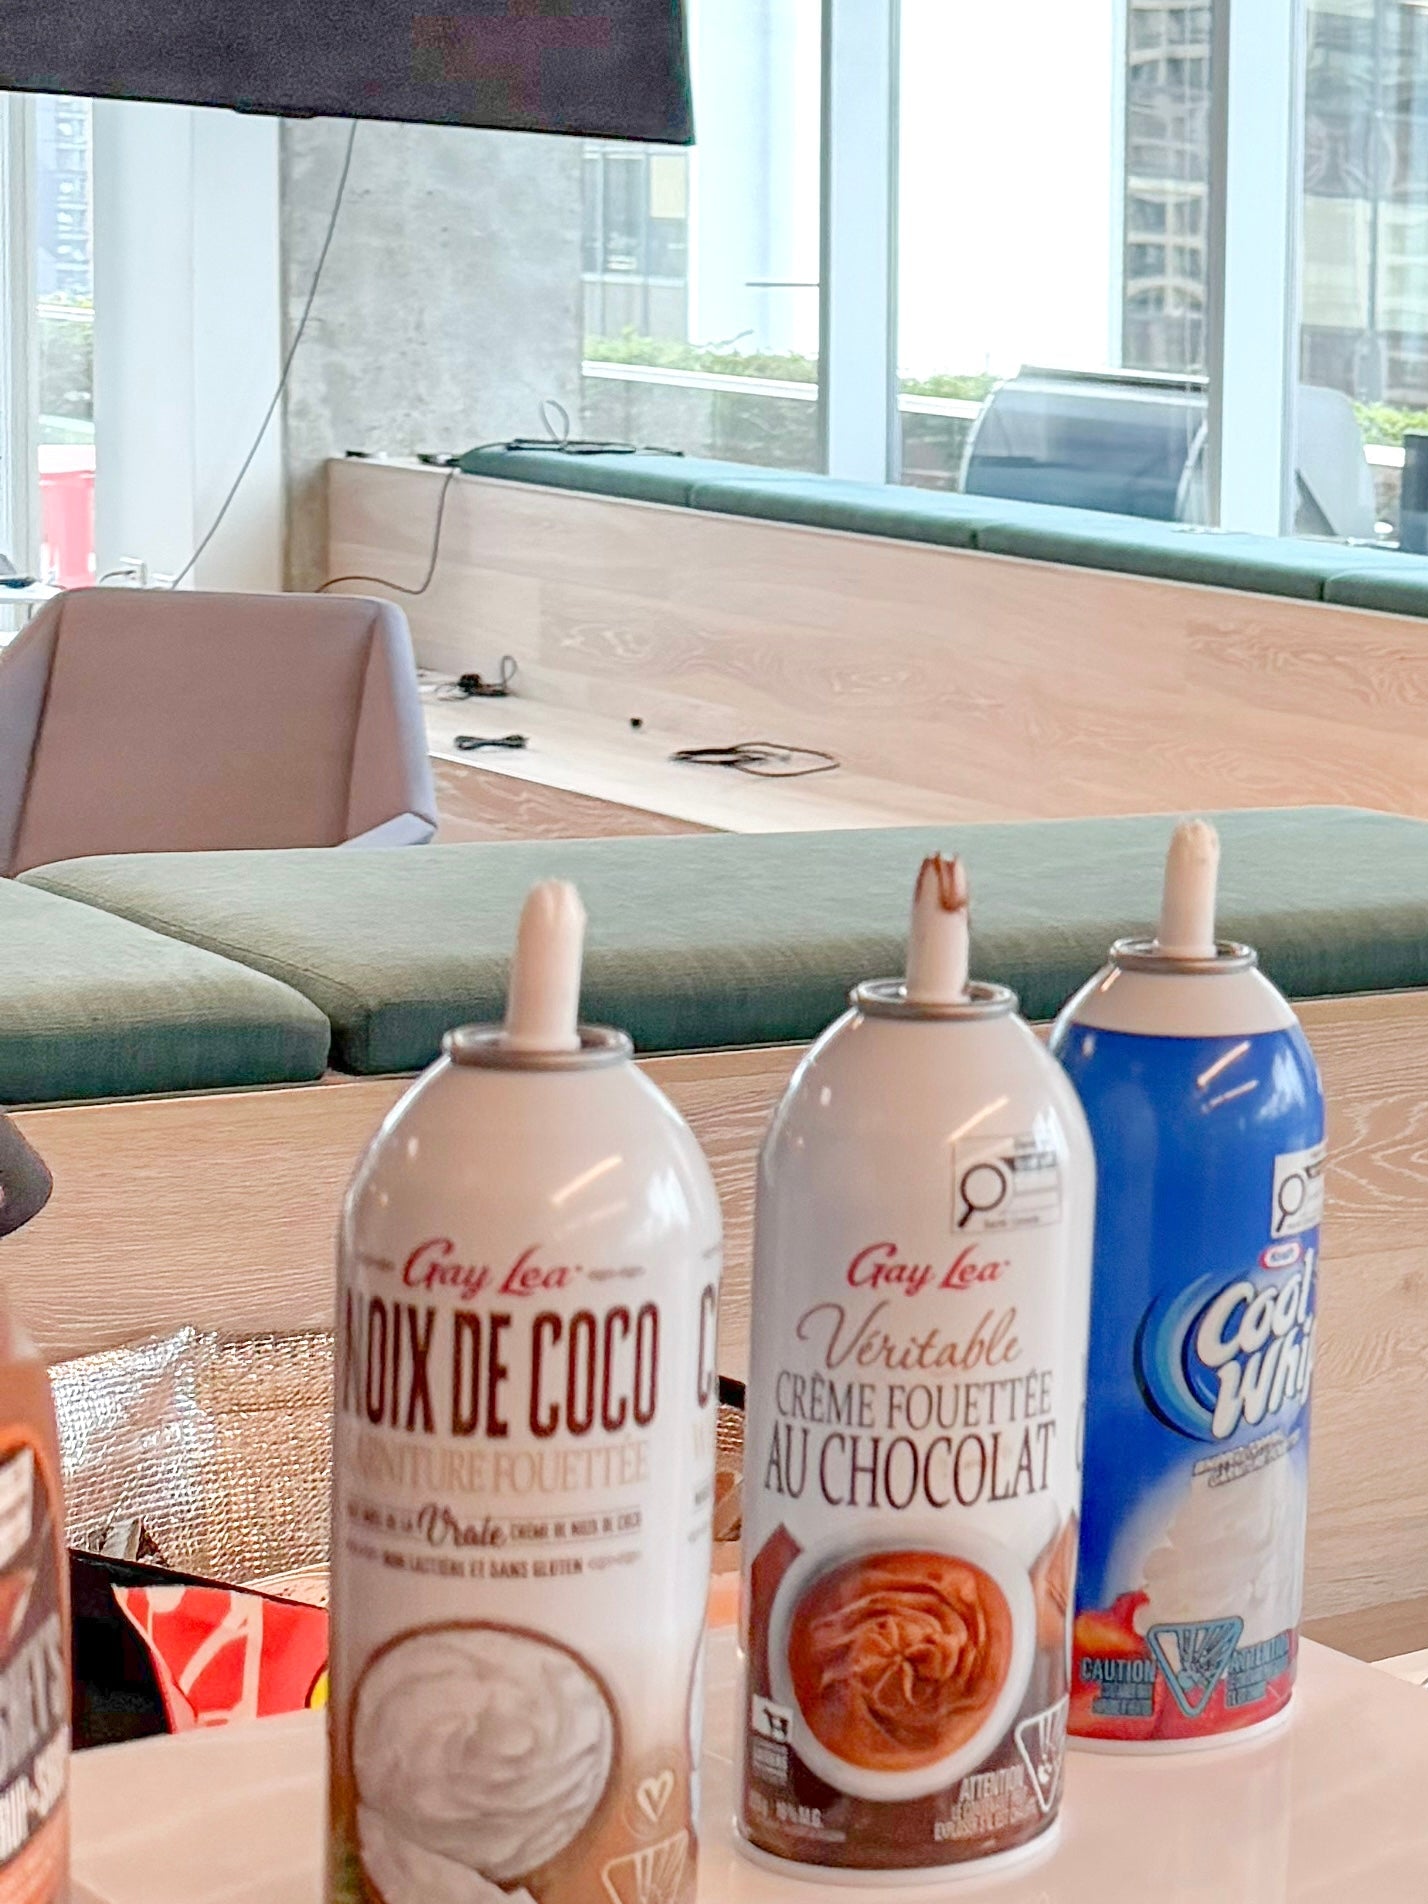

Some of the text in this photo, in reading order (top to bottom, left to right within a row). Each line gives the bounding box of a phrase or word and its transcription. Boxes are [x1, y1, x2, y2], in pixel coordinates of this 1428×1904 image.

[402, 1236, 576, 1300] Gay Lea
[847, 1242, 1002, 1296] Gay Lea
[795, 1300, 1022, 1372] Véritable
[1197, 1247, 1314, 1367] Cool
[451, 1307, 512, 1440] DE
[529, 1301, 660, 1440] COCO
[775, 1368, 877, 1429] CRÈME
[887, 1368, 1054, 1431] FOUETTÉE
[1211, 1314, 1317, 1441] Whi
[764, 1418, 1057, 1510] AU CHOCOLAT
[1080, 1656, 1156, 1684] CAUTION
